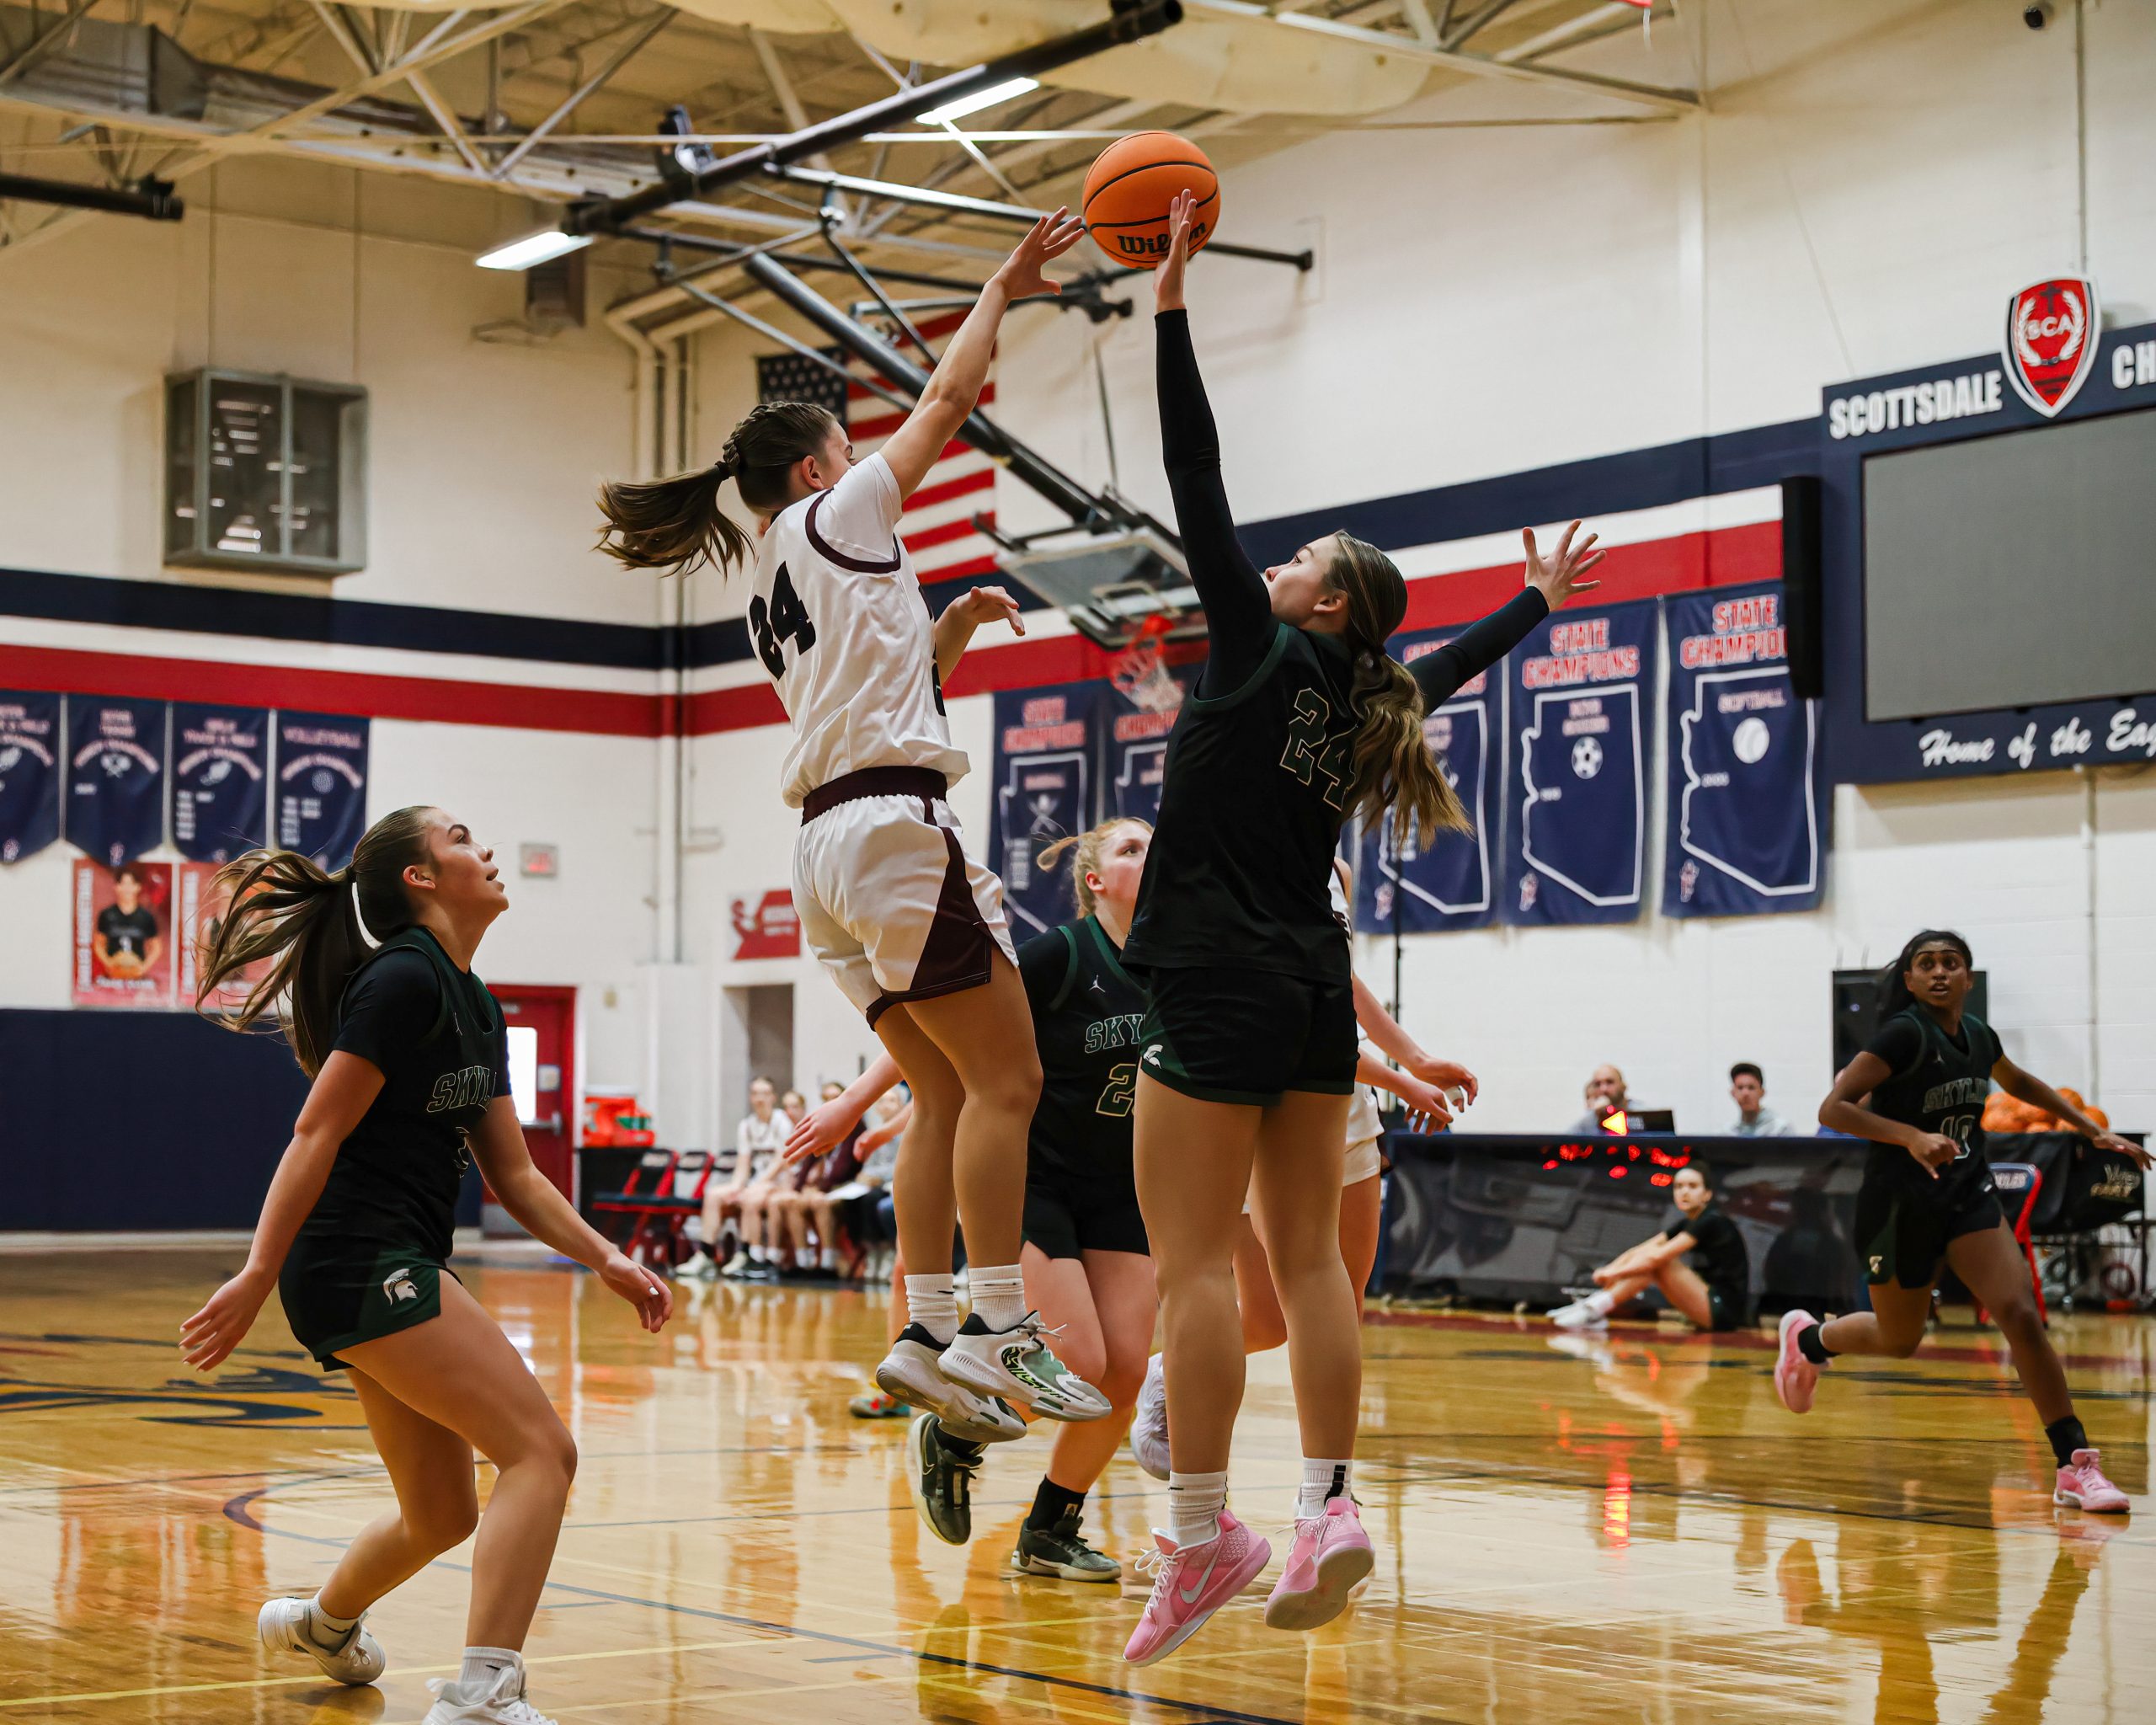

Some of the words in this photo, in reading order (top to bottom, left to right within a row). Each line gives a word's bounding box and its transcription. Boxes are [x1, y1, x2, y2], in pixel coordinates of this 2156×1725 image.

[1117, 222, 1206, 254] Wiln
[1829, 370, 2003, 440] SCOTTSDALE
[1550, 617, 1609, 656] STATE
[1712, 594, 1779, 634] STATE
[1522, 644, 1640, 689] CHAMPIONS
[1279, 687, 1359, 812] 24
[1919, 729, 1995, 767] Home
[2007, 722, 2036, 769] of
[2050, 717, 2091, 757] the
[1085, 1014, 1145, 1054] SKY
[1096, 1063, 1136, 1117] 2
